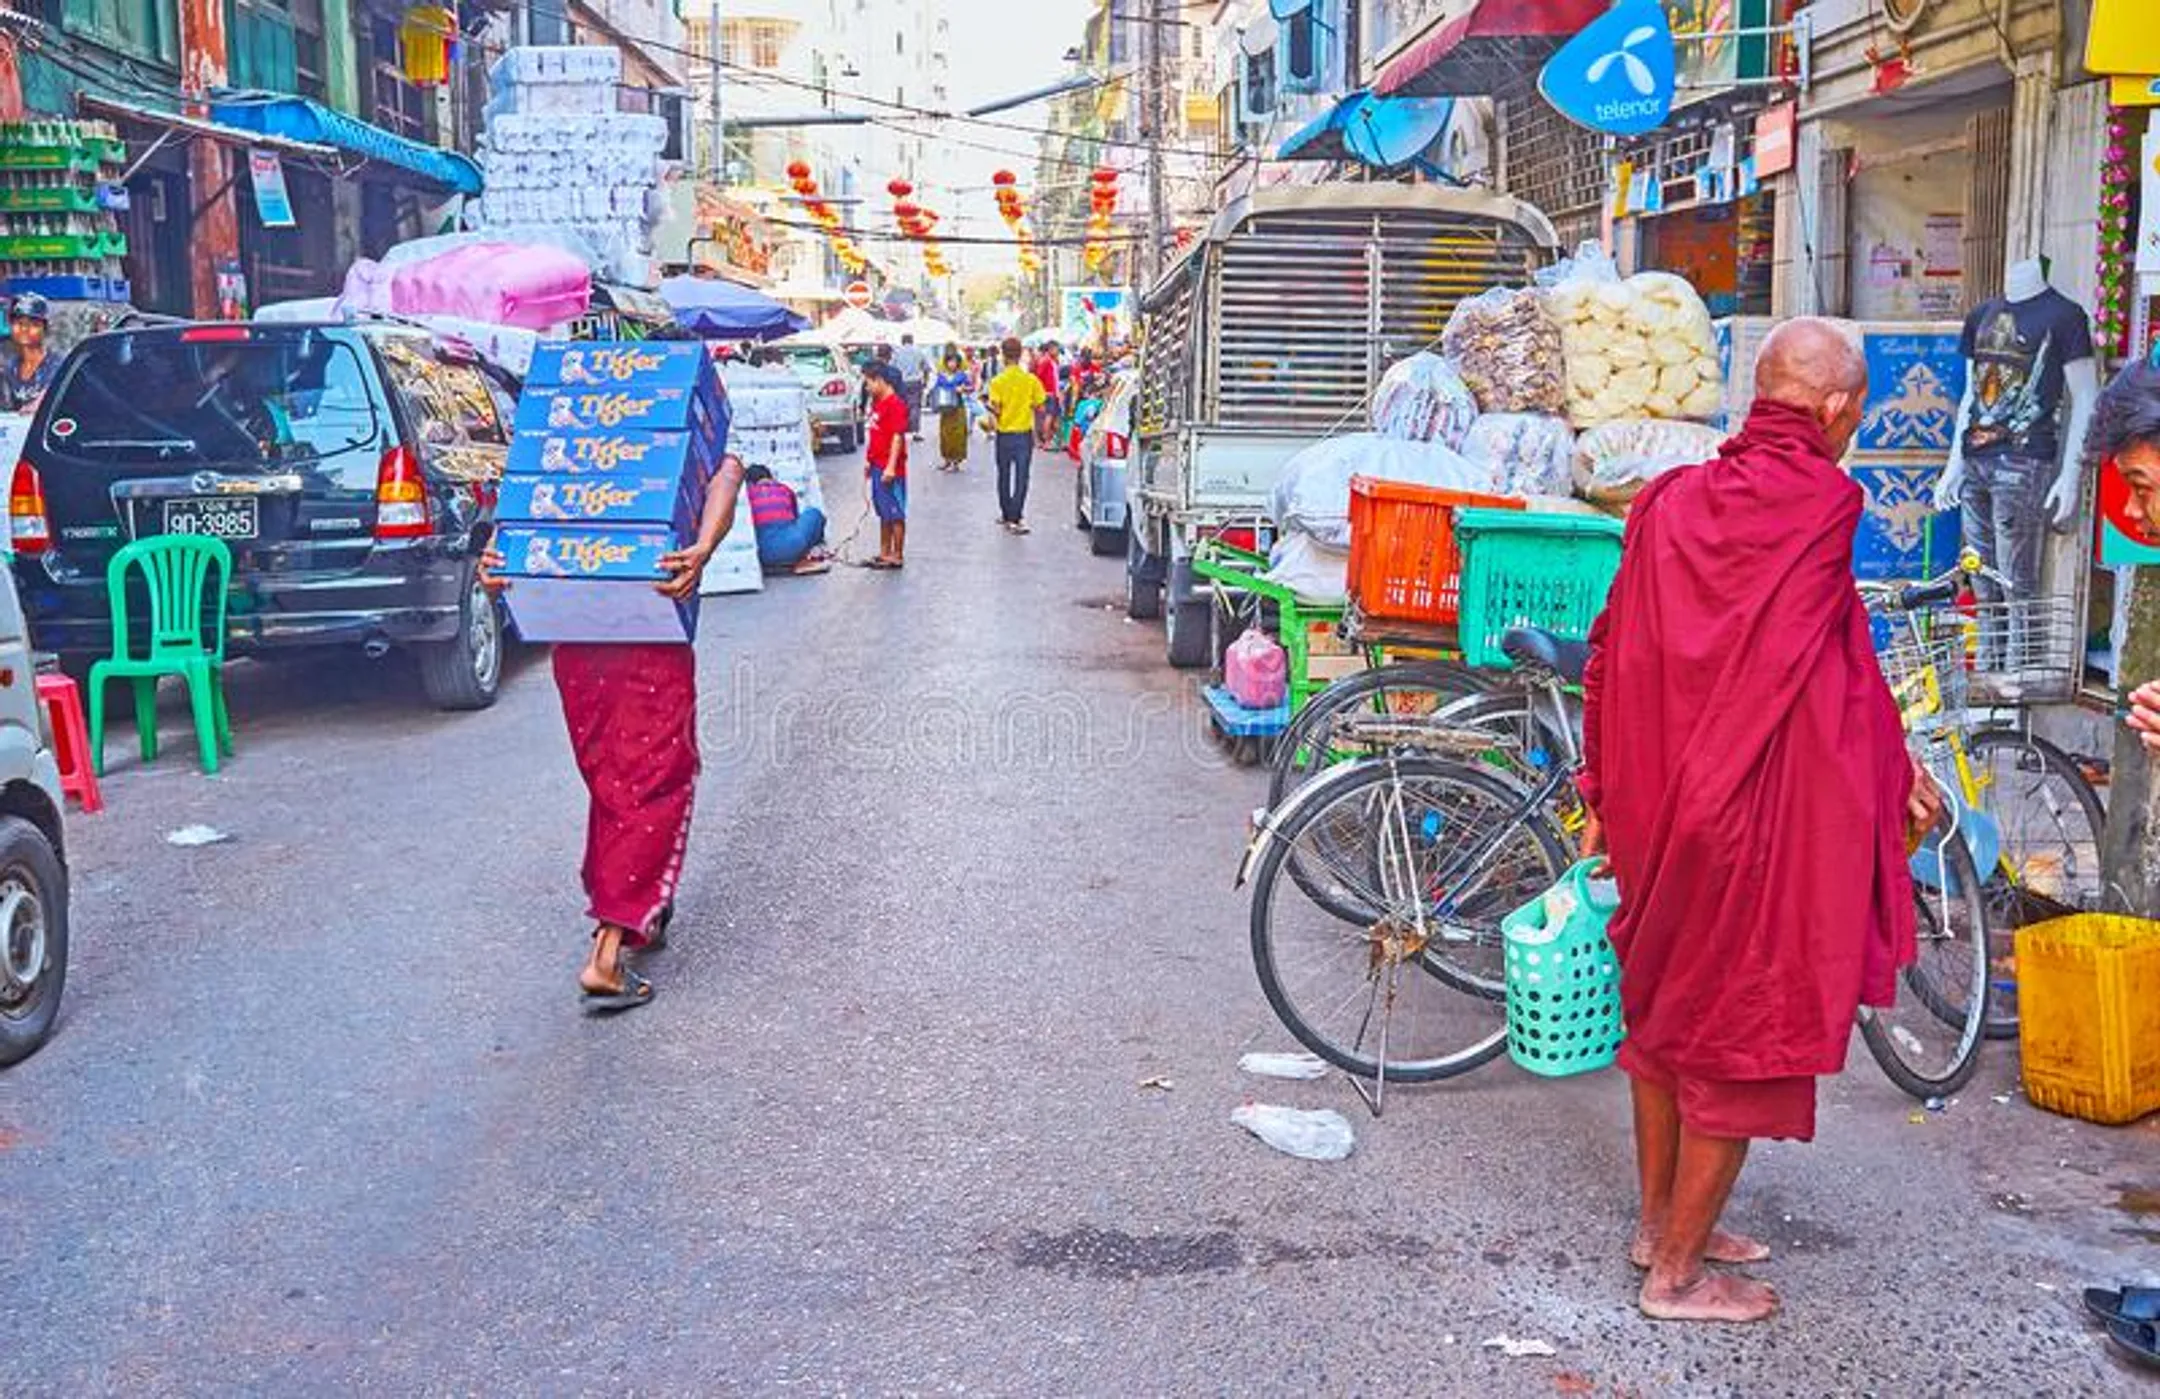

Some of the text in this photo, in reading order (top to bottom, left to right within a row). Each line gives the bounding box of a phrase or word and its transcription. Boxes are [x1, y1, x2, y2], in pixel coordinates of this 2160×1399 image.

[1595, 97, 1661, 122] telenor
[591, 347, 666, 381] Tiger
[579, 391, 655, 427] Tiger
[572, 435, 649, 471] Tiger
[561, 479, 640, 516] Tiger
[557, 535, 637, 573] Tiger
